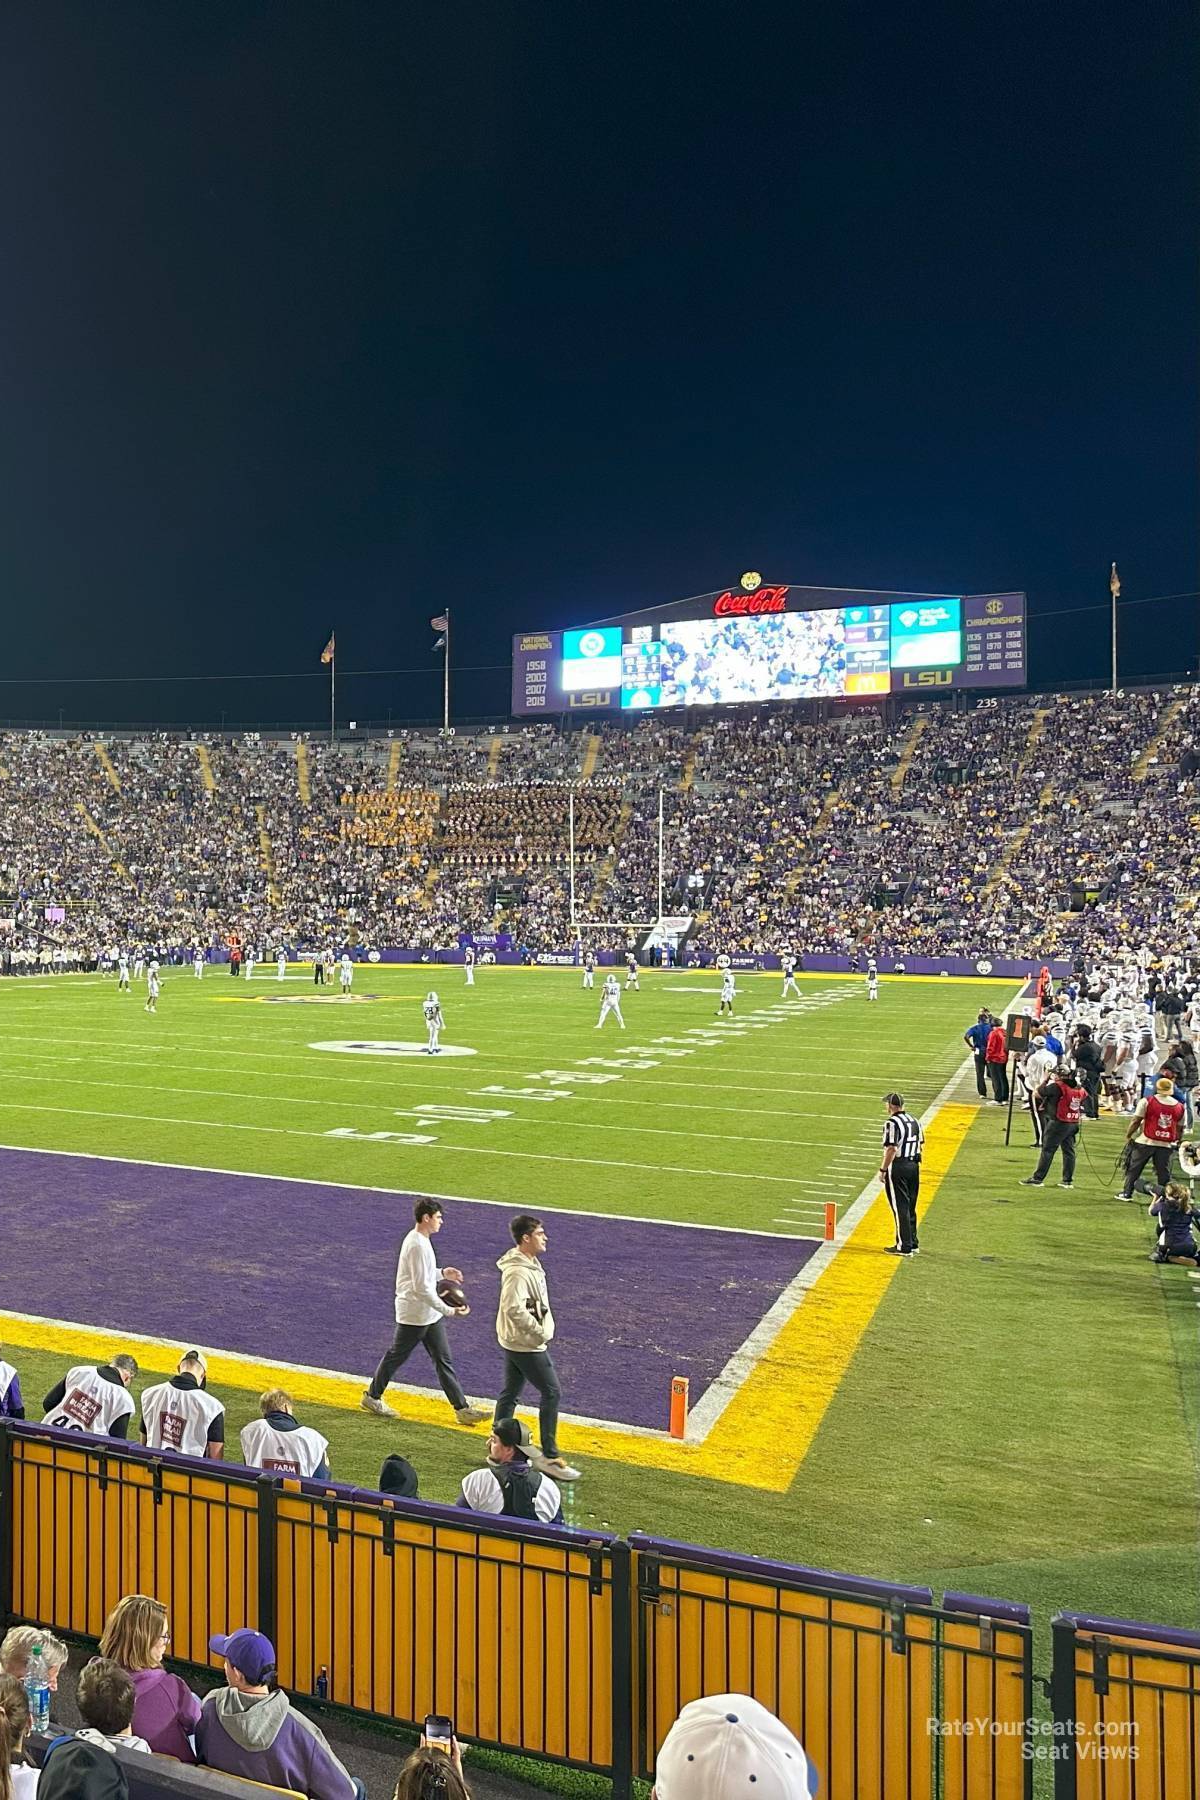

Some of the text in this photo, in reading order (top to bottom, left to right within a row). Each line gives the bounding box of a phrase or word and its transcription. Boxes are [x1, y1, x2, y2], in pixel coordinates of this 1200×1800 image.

[714, 587, 789, 615] Coca-Cola
[966, 615, 1023, 627] CHAMPIONSHIPS
[526, 660, 546, 671] 1958
[526, 672, 547, 683] 2003
[903, 671, 953, 687] LSU
[526, 684, 547, 695] 2007
[526, 695, 546, 707] 2019
[569, 691, 611, 707] LSU
[976, 698, 998, 709] 235
[1012, 1018, 1023, 1038] 1
[392, 1104, 516, 1123] 10
[322, 1127, 440, 1144] 5
[906, 1122, 917, 1142] L
[69, 1398, 94, 1418] BUREAU
[79, 1395, 97, 1412] FARM
[273, 1463, 296, 1474] FARM
